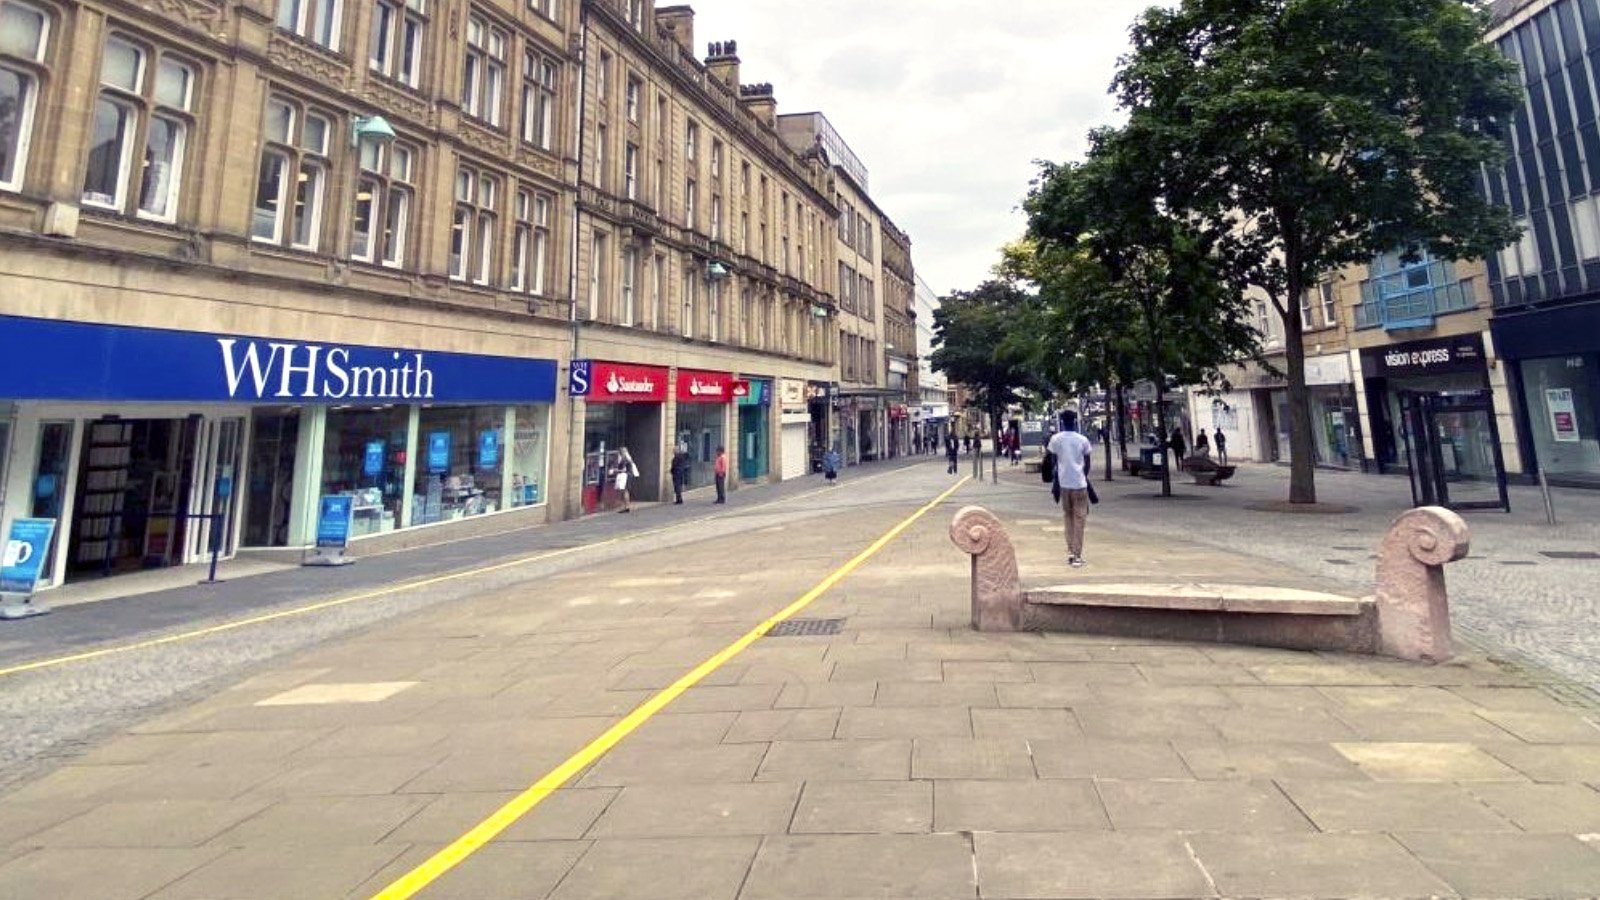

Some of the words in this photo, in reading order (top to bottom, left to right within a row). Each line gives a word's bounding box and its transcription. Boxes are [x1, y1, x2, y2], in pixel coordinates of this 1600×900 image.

[1385, 350, 1410, 366] vision
[216, 339, 435, 398] WHSmith
[571, 368, 588, 393] S
[618, 376, 655, 392] Santander
